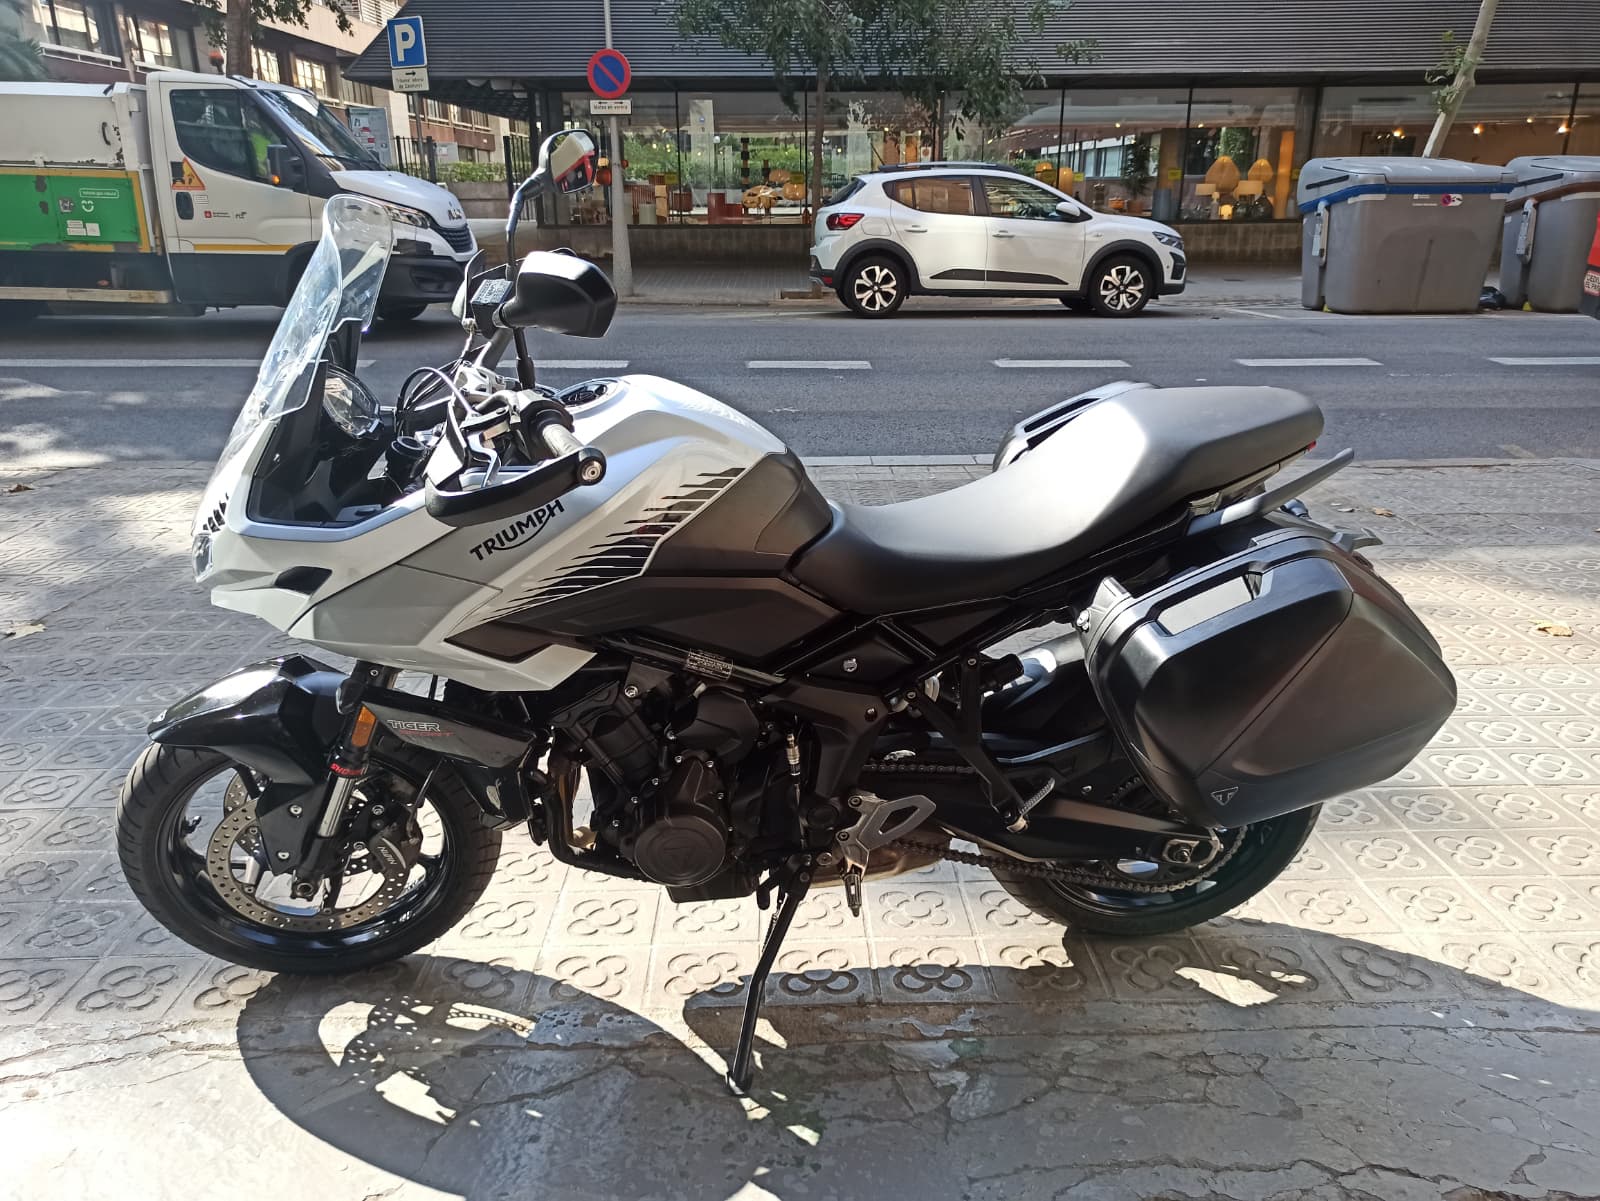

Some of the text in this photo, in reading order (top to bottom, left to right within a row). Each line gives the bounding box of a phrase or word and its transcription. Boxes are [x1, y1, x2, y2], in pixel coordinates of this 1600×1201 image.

[394, 23, 416, 62] P
[469, 499, 565, 561] TRIUMPH
[386, 719, 441, 732] TIGER
